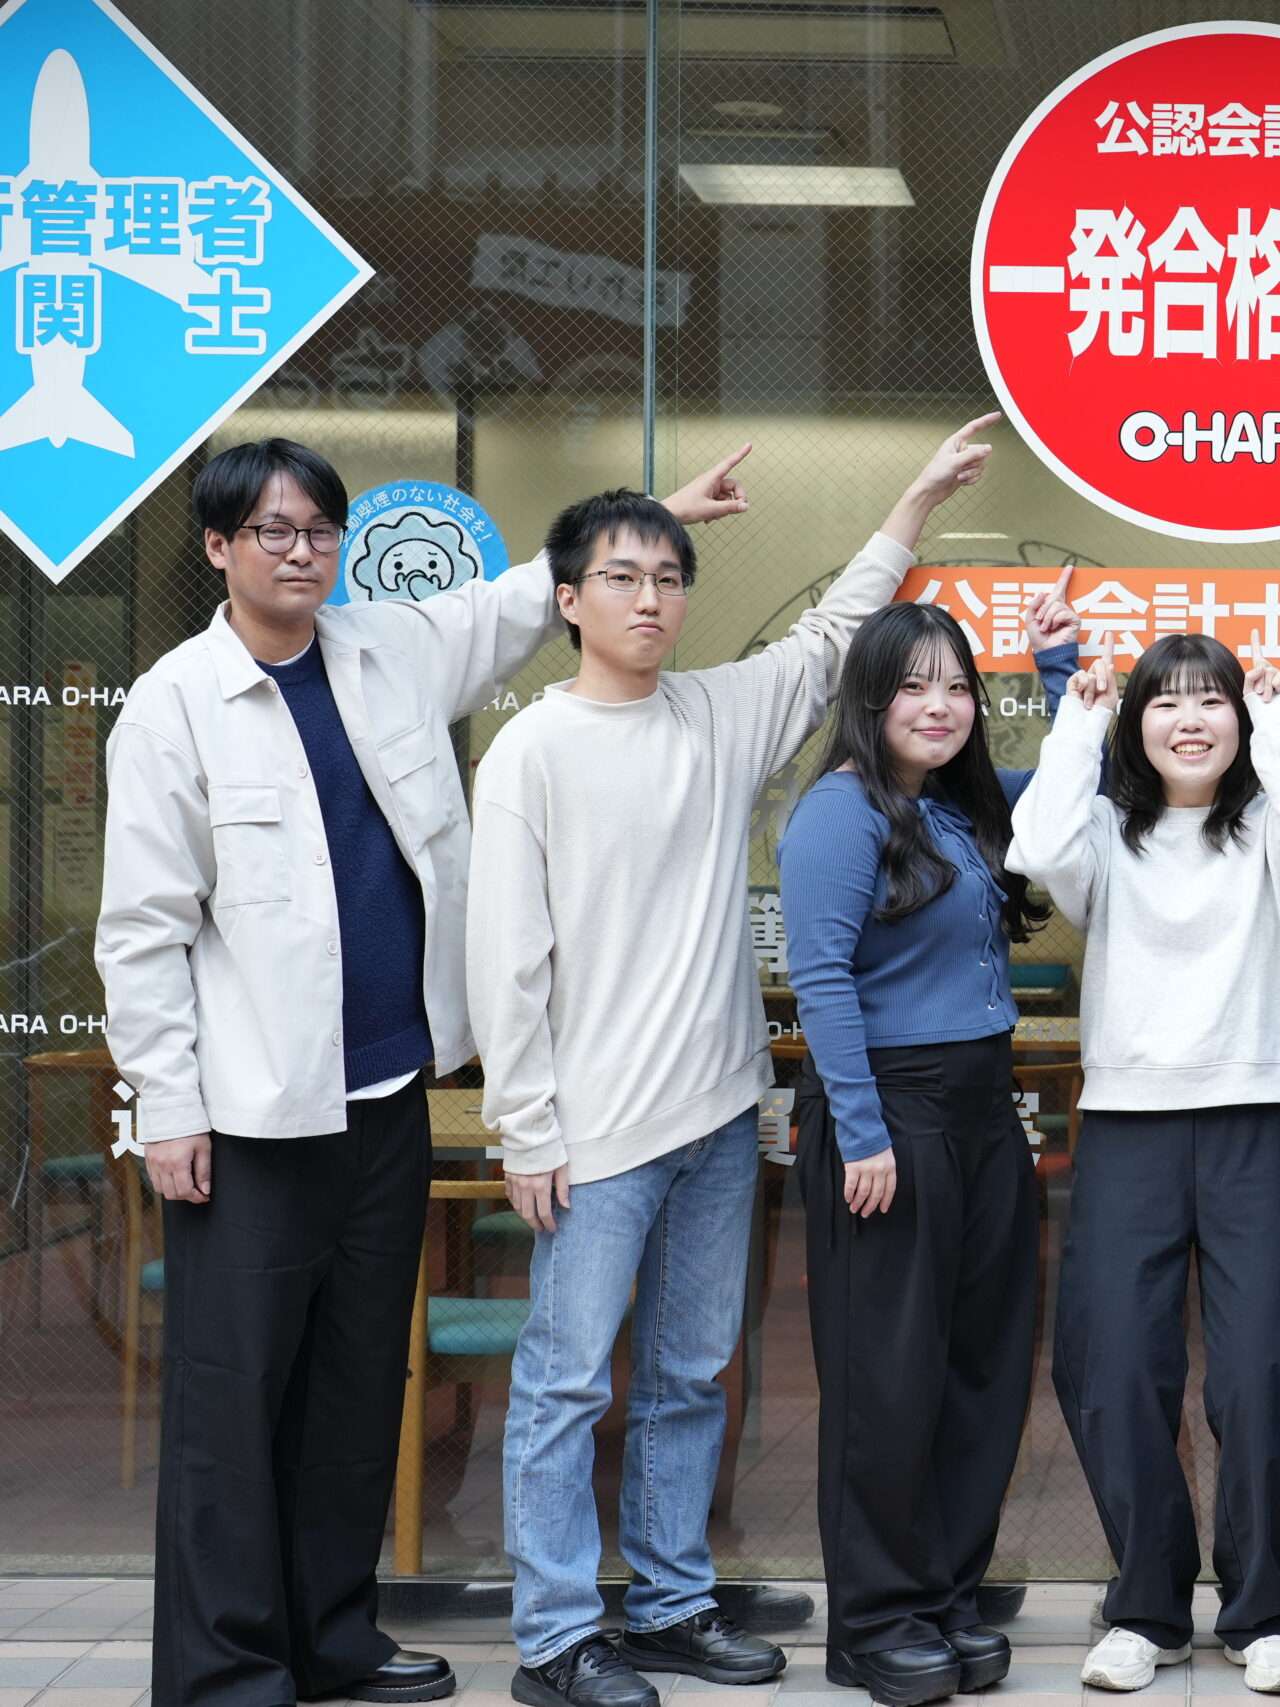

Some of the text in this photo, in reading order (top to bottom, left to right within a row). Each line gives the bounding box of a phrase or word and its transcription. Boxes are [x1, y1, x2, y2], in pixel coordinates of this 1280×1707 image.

[0, 178, 266, 260] 管理者
[343, 485, 493, 547] 動喫煙のない社会を!
